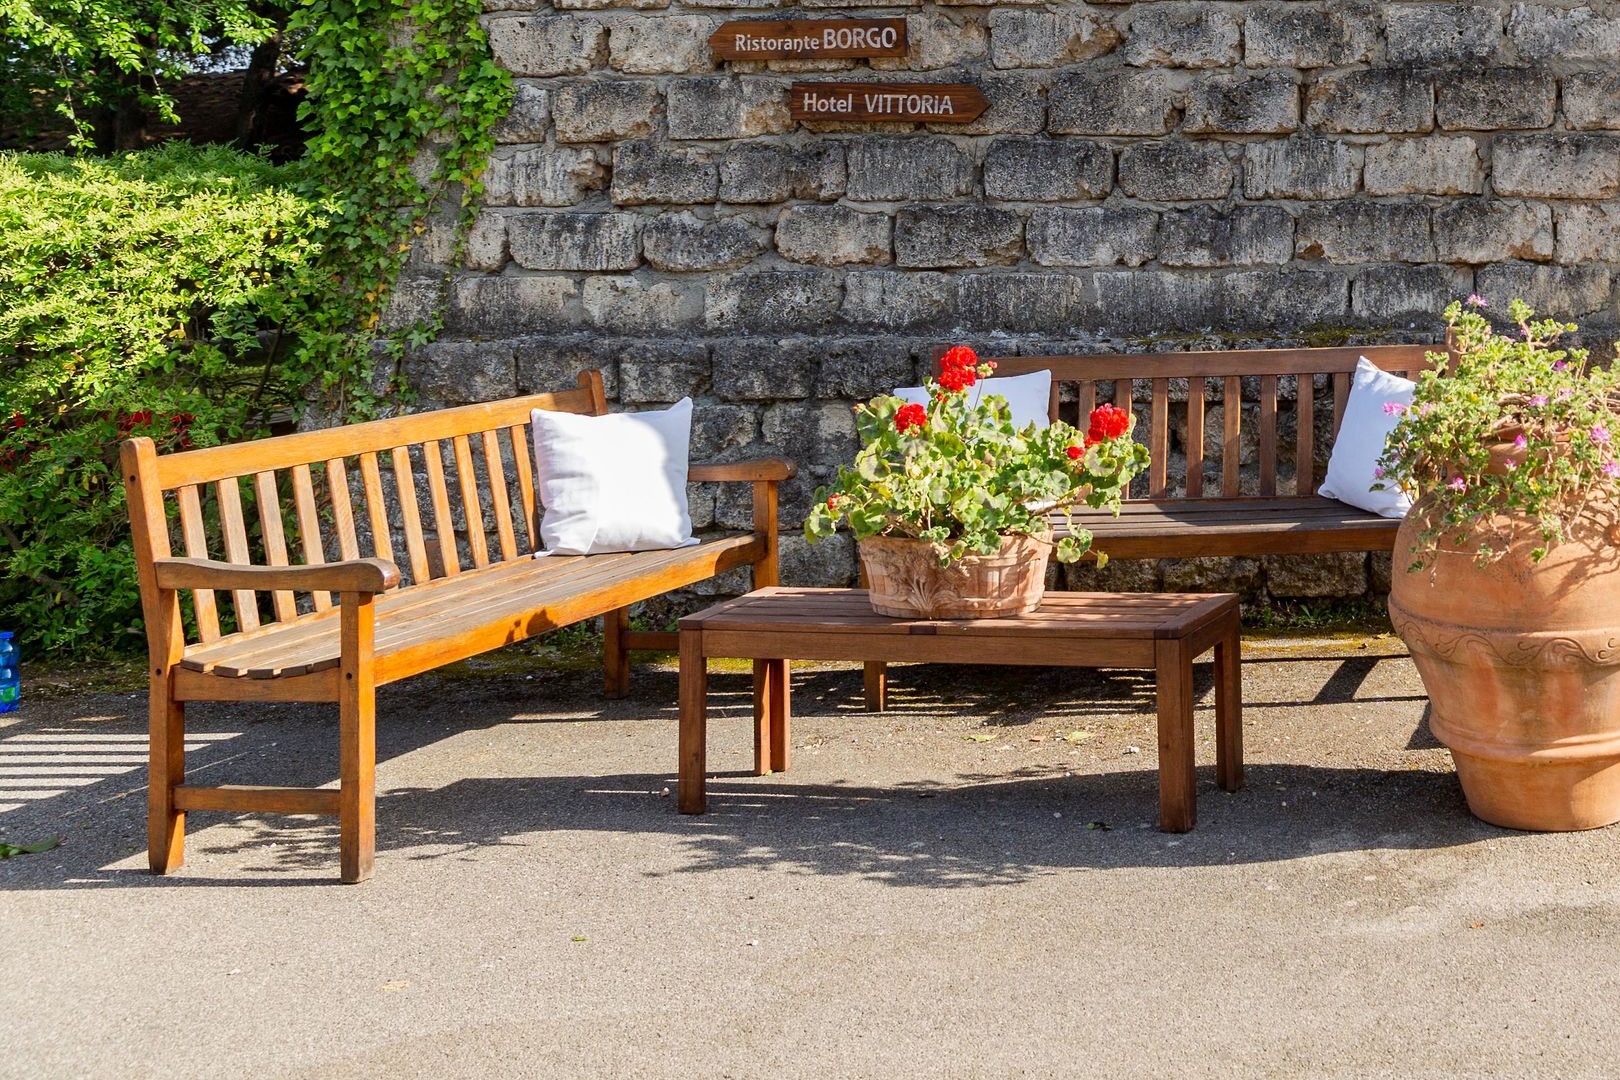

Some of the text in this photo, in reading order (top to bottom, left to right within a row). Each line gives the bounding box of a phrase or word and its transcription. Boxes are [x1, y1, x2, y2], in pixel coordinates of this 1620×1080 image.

[735, 26, 897, 53] Ristorante BORGO
[803, 92, 954, 115] Hotel VITTORIA
